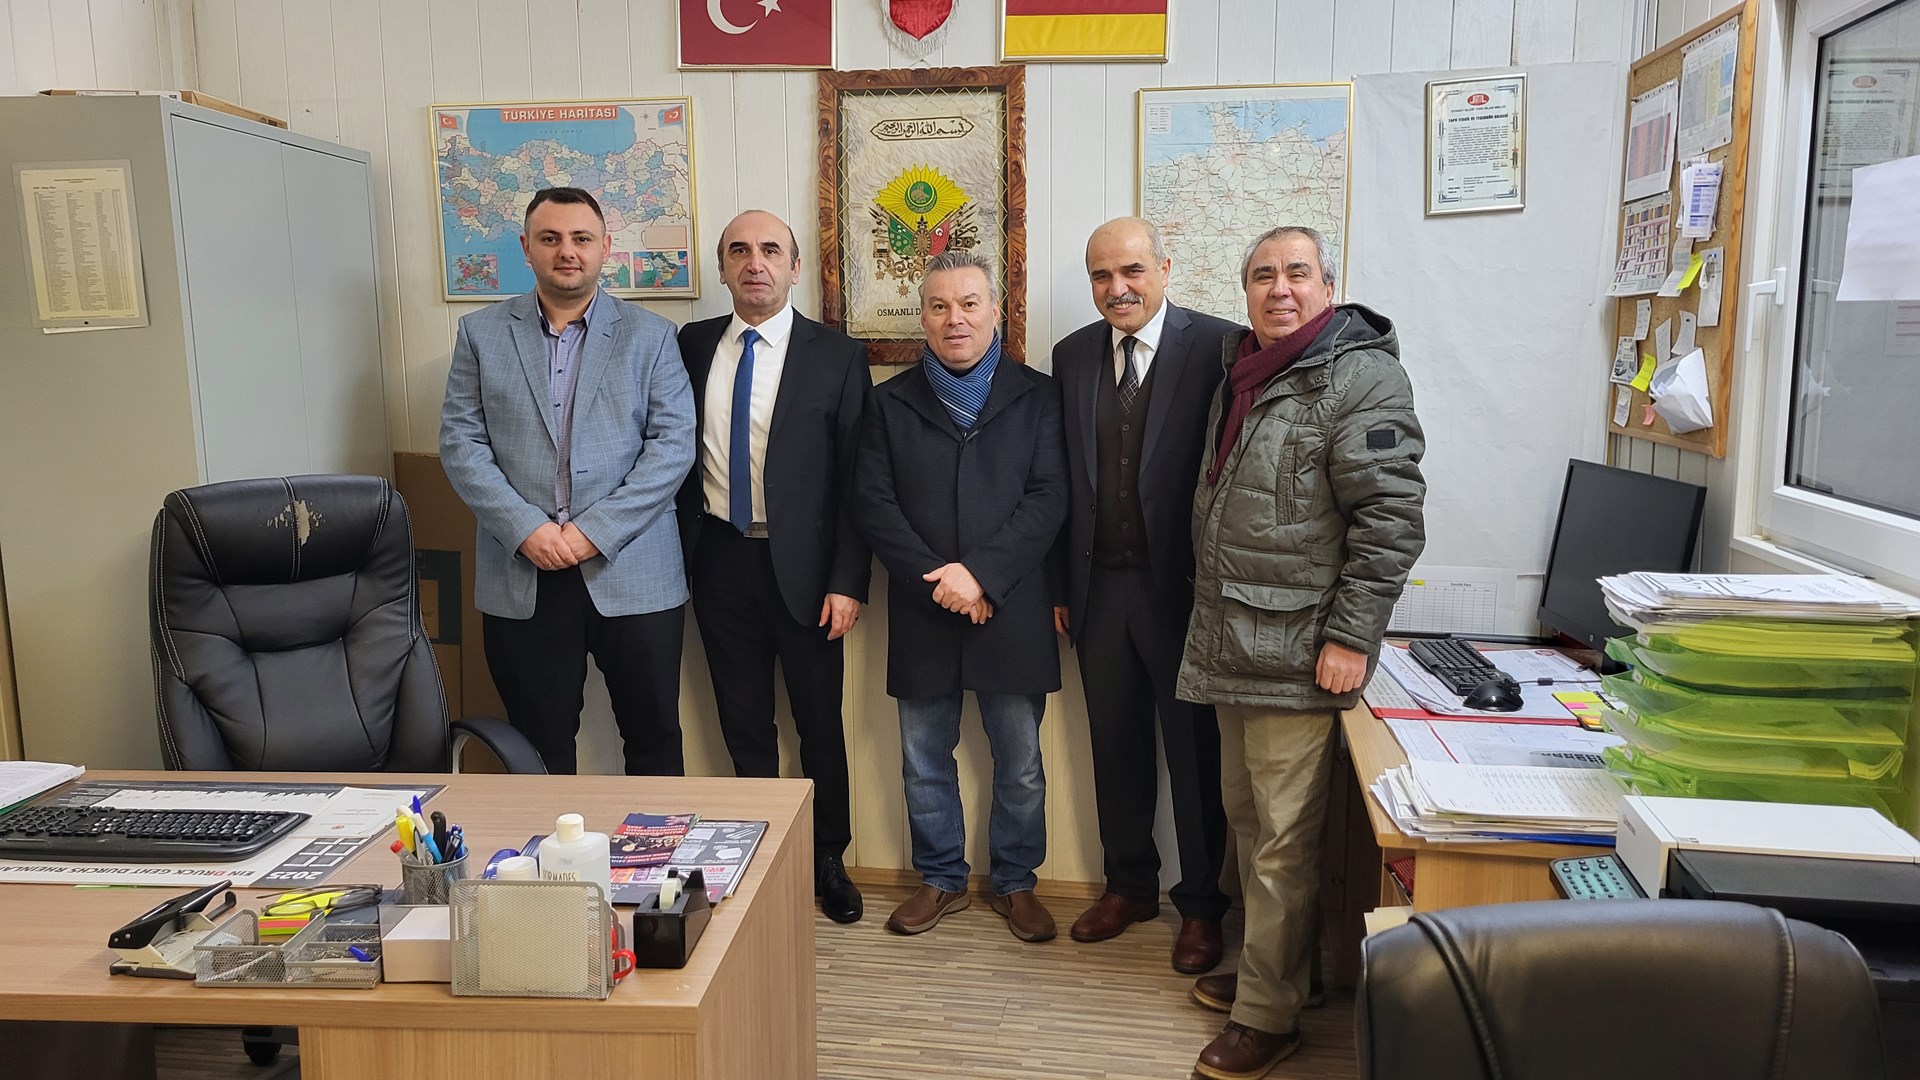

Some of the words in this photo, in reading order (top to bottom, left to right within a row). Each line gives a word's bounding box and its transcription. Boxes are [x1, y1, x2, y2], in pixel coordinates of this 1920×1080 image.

[877, 307, 914, 317] OSMANLI
[66, 866, 129, 875] DURCHS
[128, 867, 171, 876] GEHT
[172, 868, 226, 877] DRUCK
[265, 871, 324, 880] 2025
